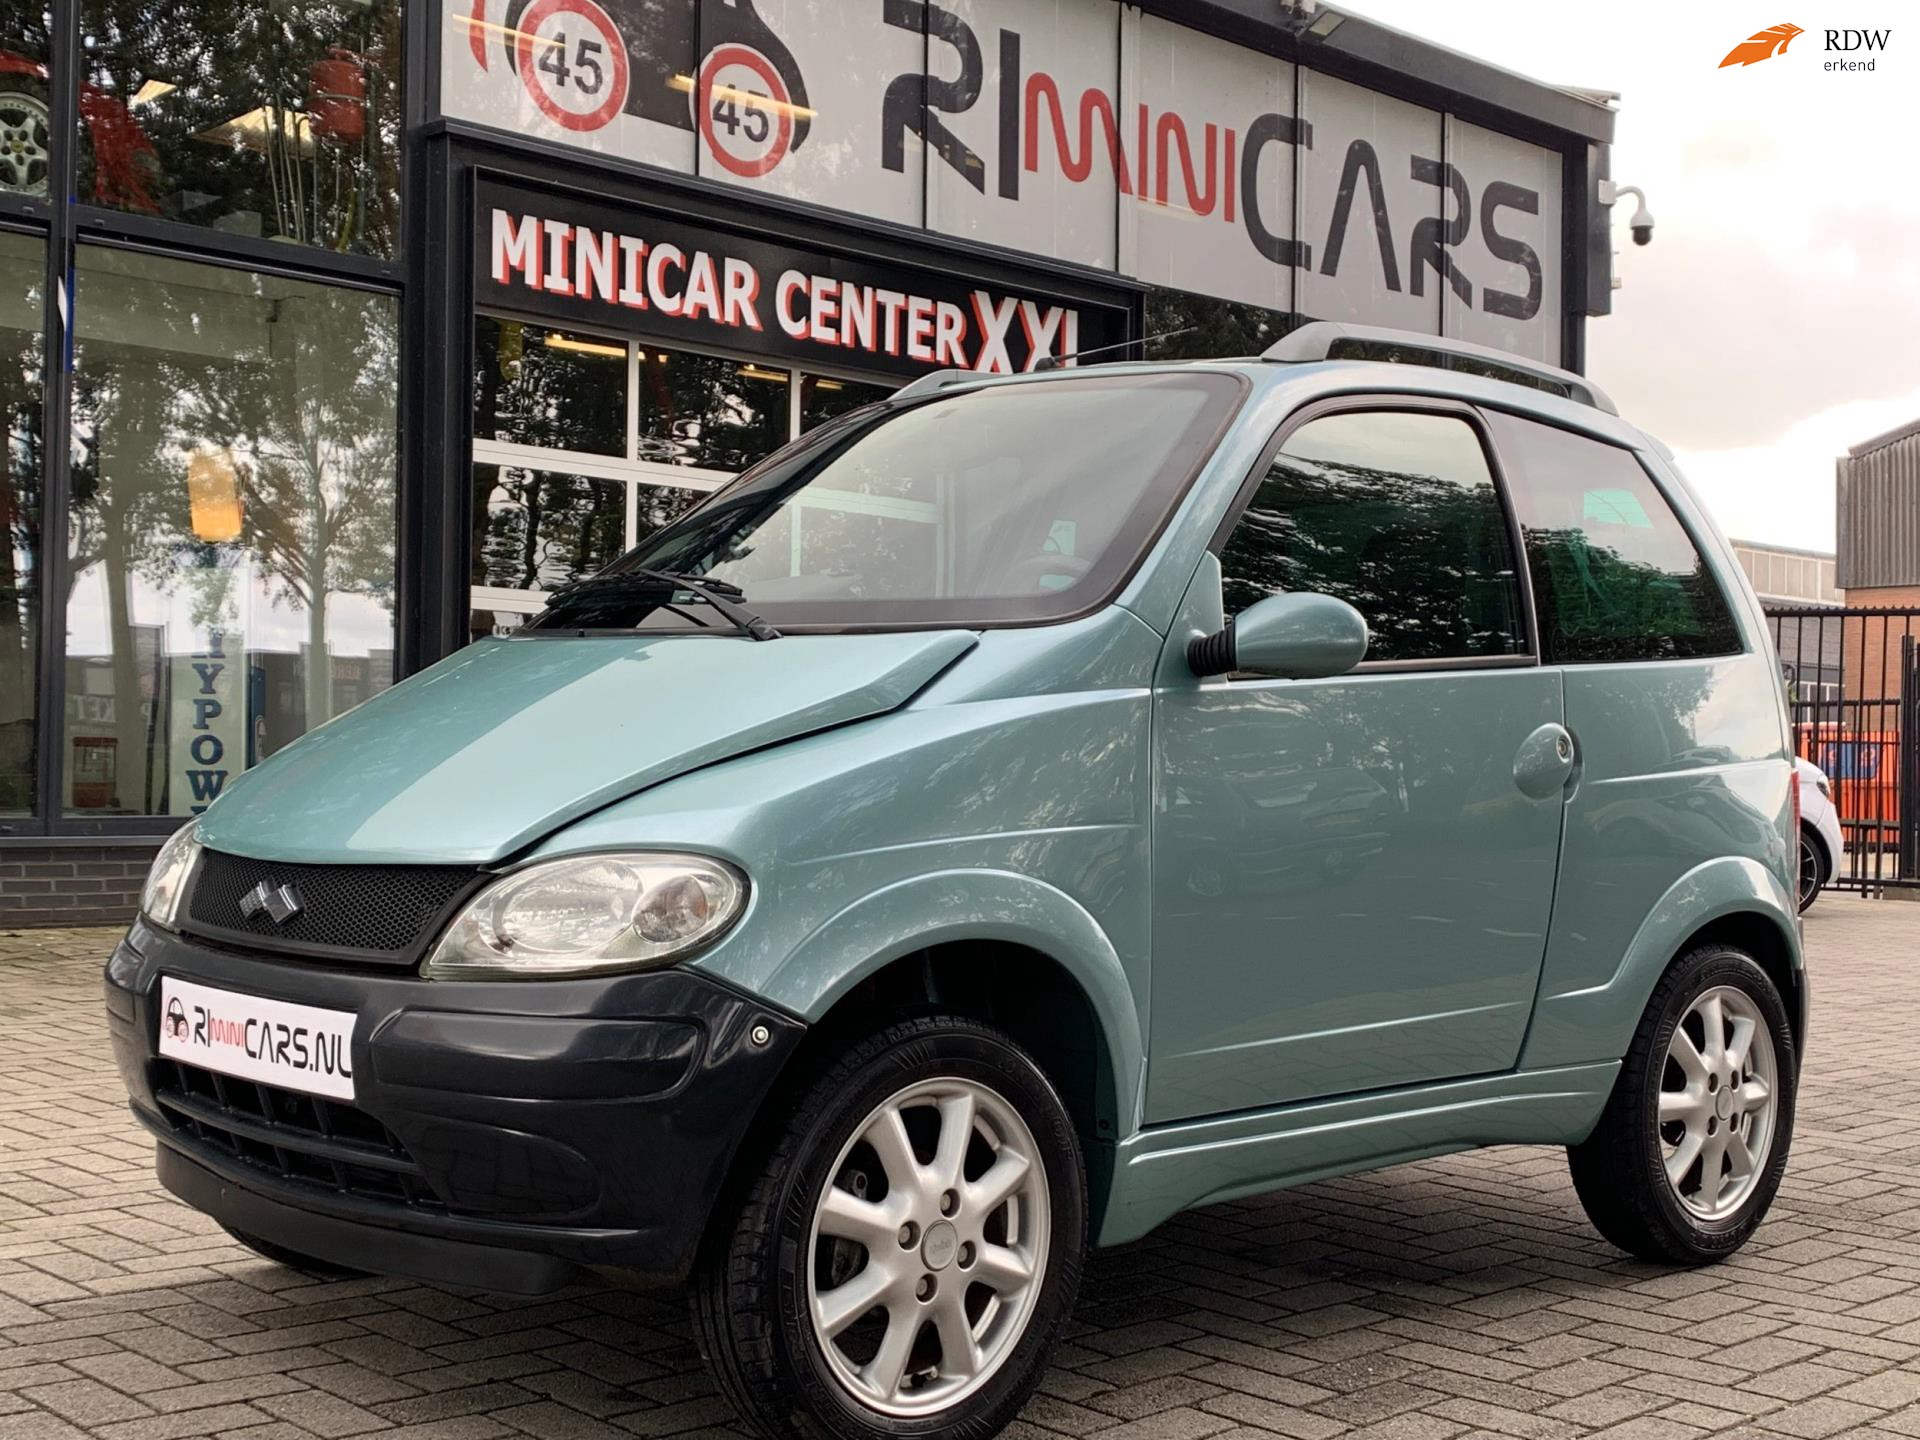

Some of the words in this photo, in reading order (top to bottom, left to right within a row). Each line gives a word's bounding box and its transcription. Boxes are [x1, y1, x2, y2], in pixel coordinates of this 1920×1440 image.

[538, 31, 603, 95] 45
[712, 83, 769, 142] 45
[491, 209, 761, 329] MINICAR
[775, 269, 967, 368] CENTER
